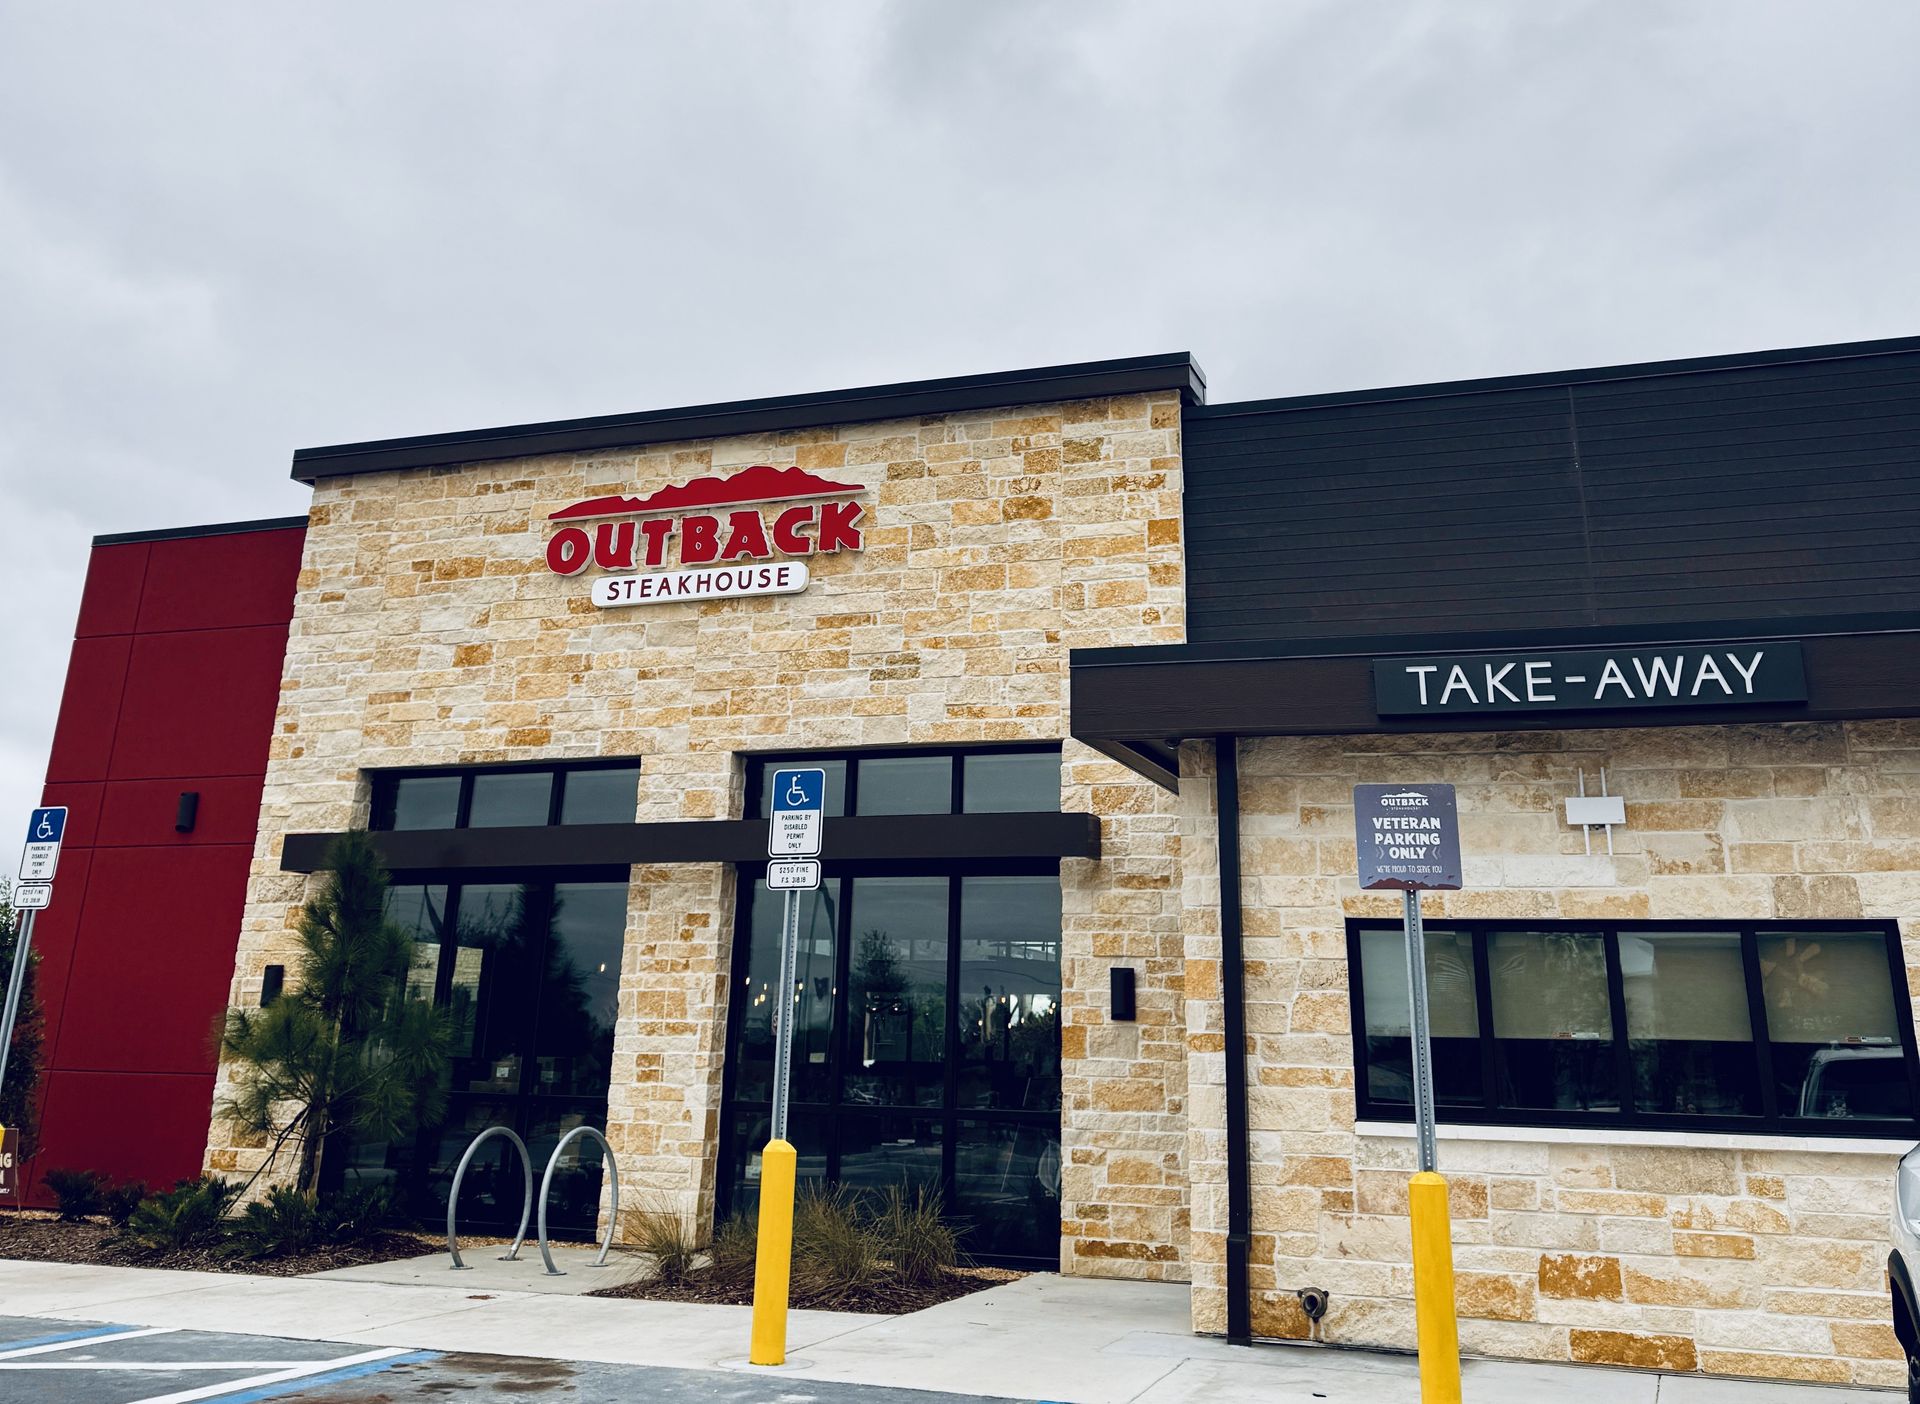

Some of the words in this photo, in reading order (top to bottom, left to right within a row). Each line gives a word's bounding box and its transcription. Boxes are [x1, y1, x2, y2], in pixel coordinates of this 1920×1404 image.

[546, 501, 866, 576] OUTBACK
[606, 566, 790, 600] STEAKHOUSE
[1405, 651, 1764, 705] TAKE-AWAY
[1380, 798, 1429, 806] OUTBACK
[1372, 817, 1441, 830] VETERAN
[1374, 832, 1441, 846] PARKING
[1389, 847, 1427, 859] ONLY
[1391, 865, 1407, 873] PROUD
[1408, 865, 1415, 873] TO
[1416, 865, 1431, 873] SERVE
[1432, 865, 1443, 873] YOU
